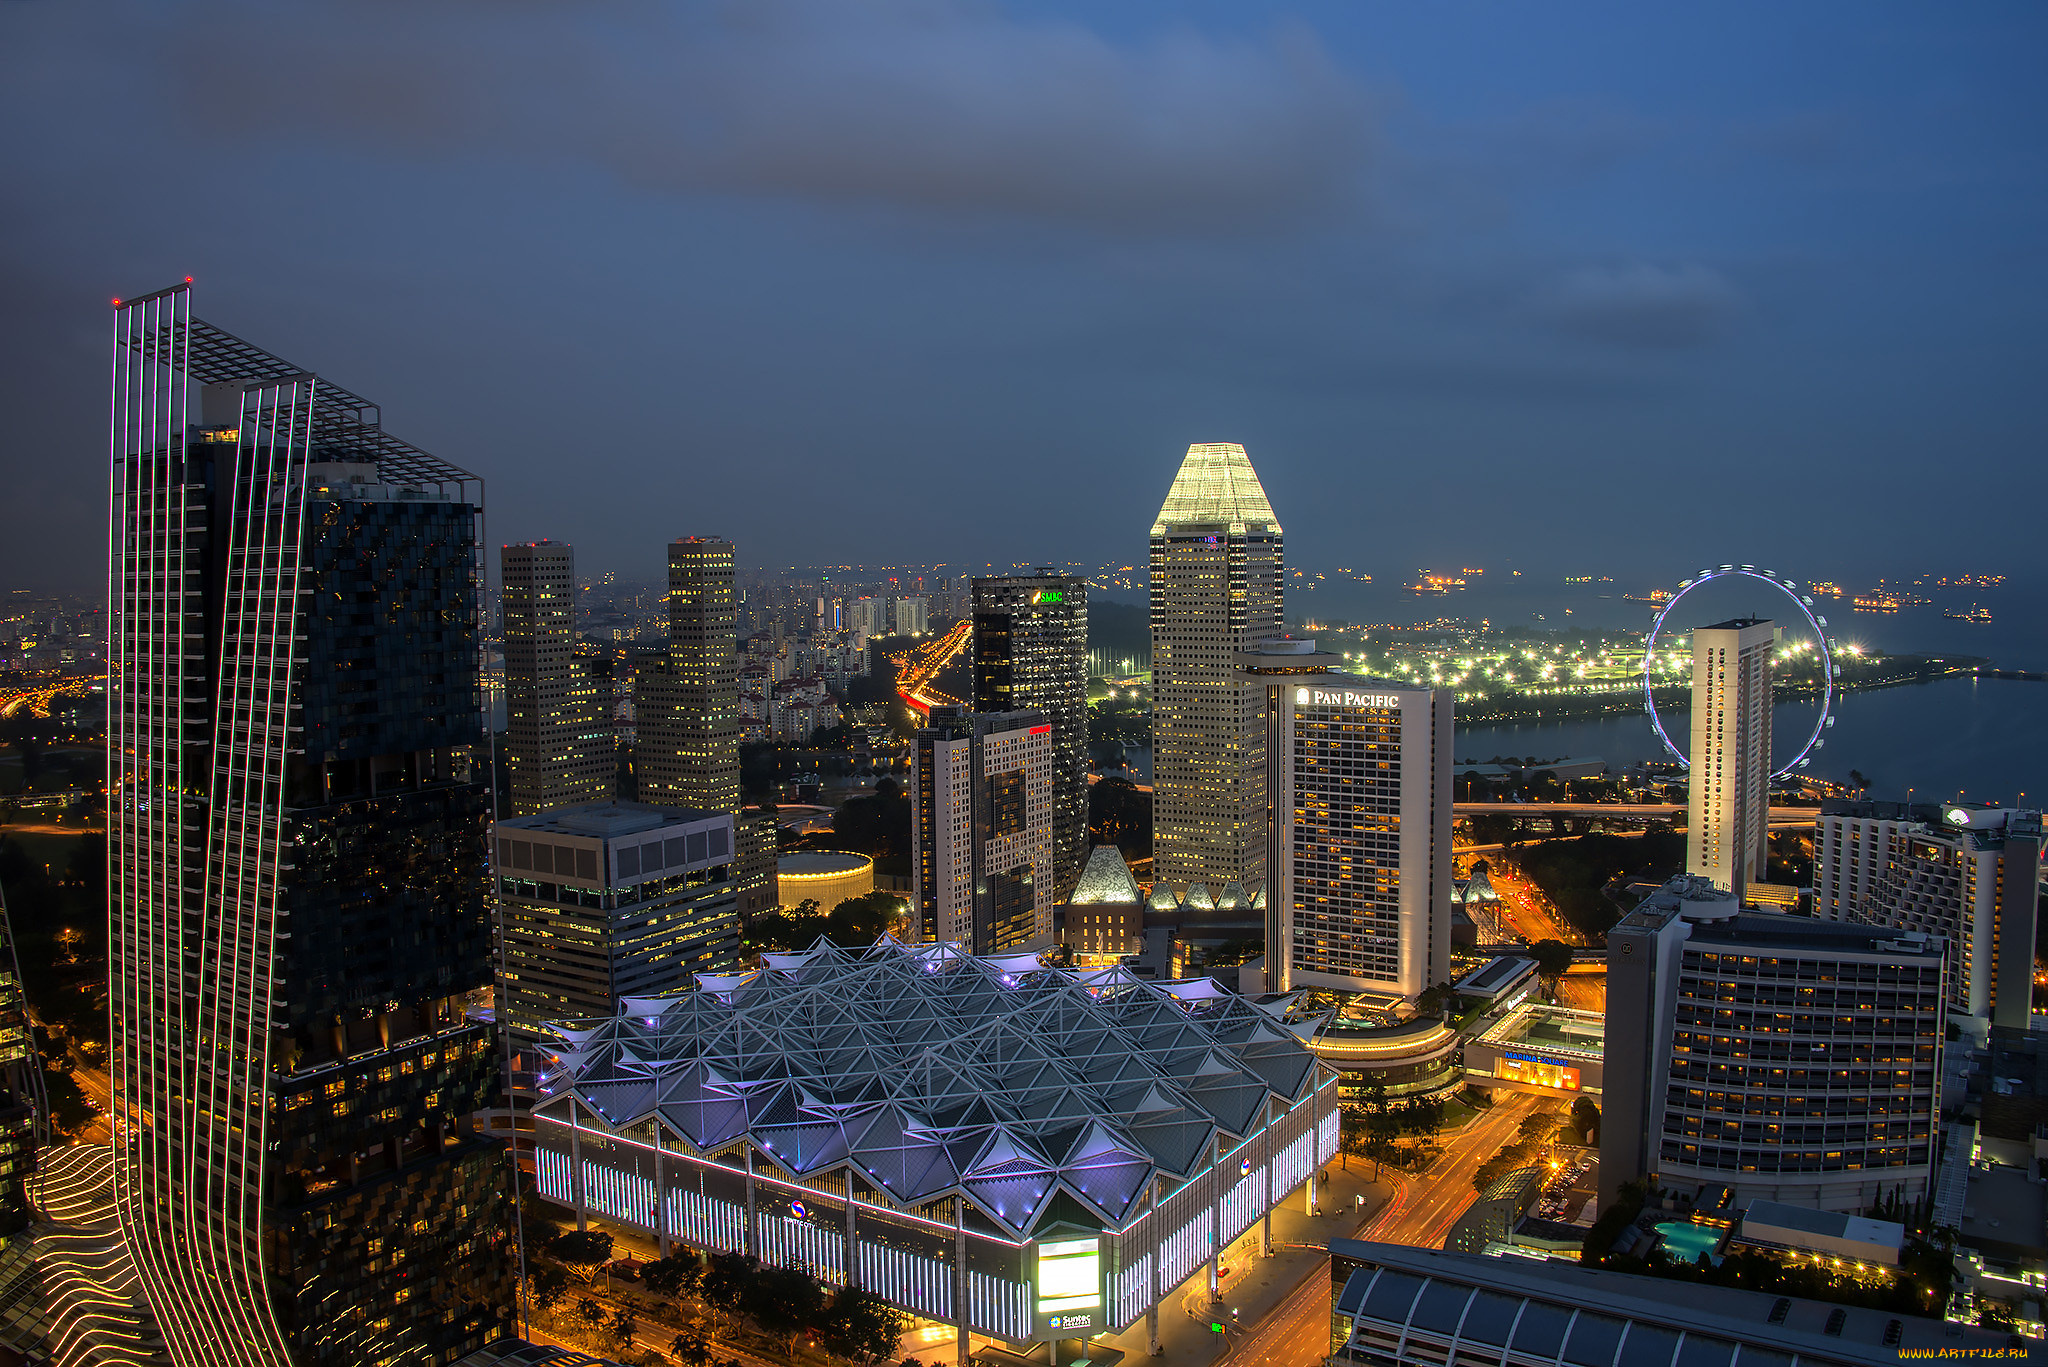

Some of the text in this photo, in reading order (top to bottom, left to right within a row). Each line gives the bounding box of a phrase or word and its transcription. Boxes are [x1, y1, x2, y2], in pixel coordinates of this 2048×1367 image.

[1041, 592, 1062, 602] SMBC
[1314, 690, 1399, 707] PAN PACIFIC
[1505, 1051, 1569, 1067] MARINA SQUARE
